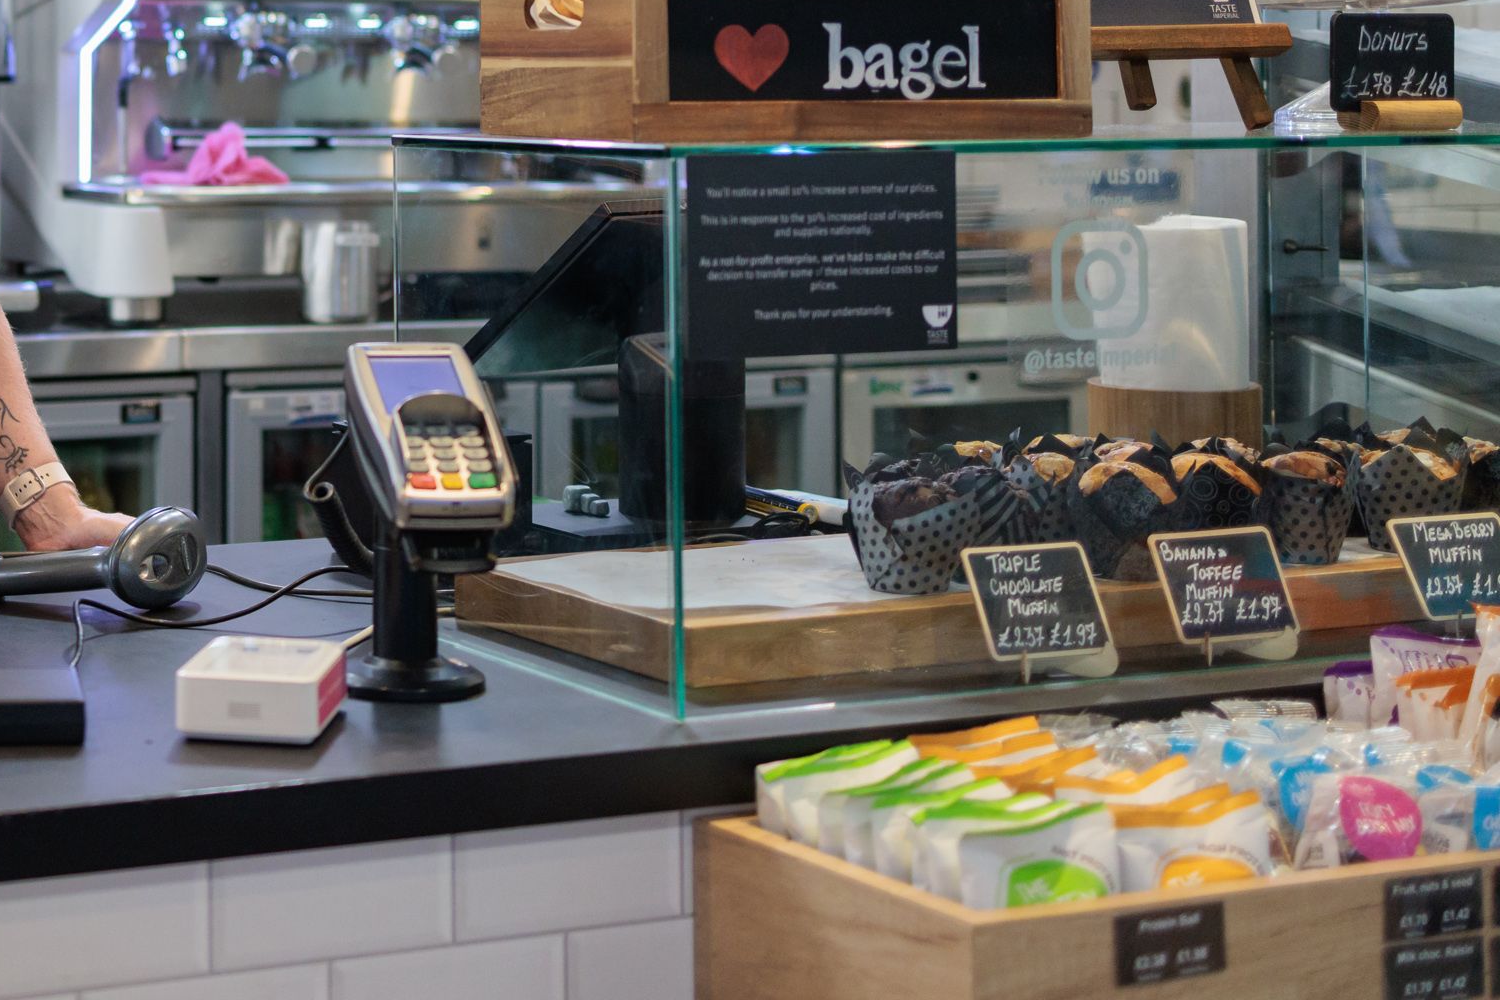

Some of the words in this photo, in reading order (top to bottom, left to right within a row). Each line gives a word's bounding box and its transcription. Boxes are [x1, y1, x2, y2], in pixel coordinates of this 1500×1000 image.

[1210, 4, 1237, 13] TASTE
[1358, 25, 1429, 51] DONUTS
[822, 21, 987, 101] bagel
[1340, 65, 1392, 98] £1.78
[1398, 66, 1448, 98] £1.48
[1107, 167, 1130, 185] us
[1135, 166, 1160, 184] on
[1160, 542, 1217, 562] BANANA
[1428, 545, 1482, 564] MUFFIN
[985, 554, 1042, 576] TRIPLE
[1187, 564, 1243, 581] TOFFEE
[989, 576, 1063, 595] CHOCOLATE
[1185, 582, 1234, 601] MUFFIN
[1007, 598, 1060, 617] MUFFIN
[1235, 597, 1284, 622] £1.97
[1050, 622, 1098, 646] £1.97
